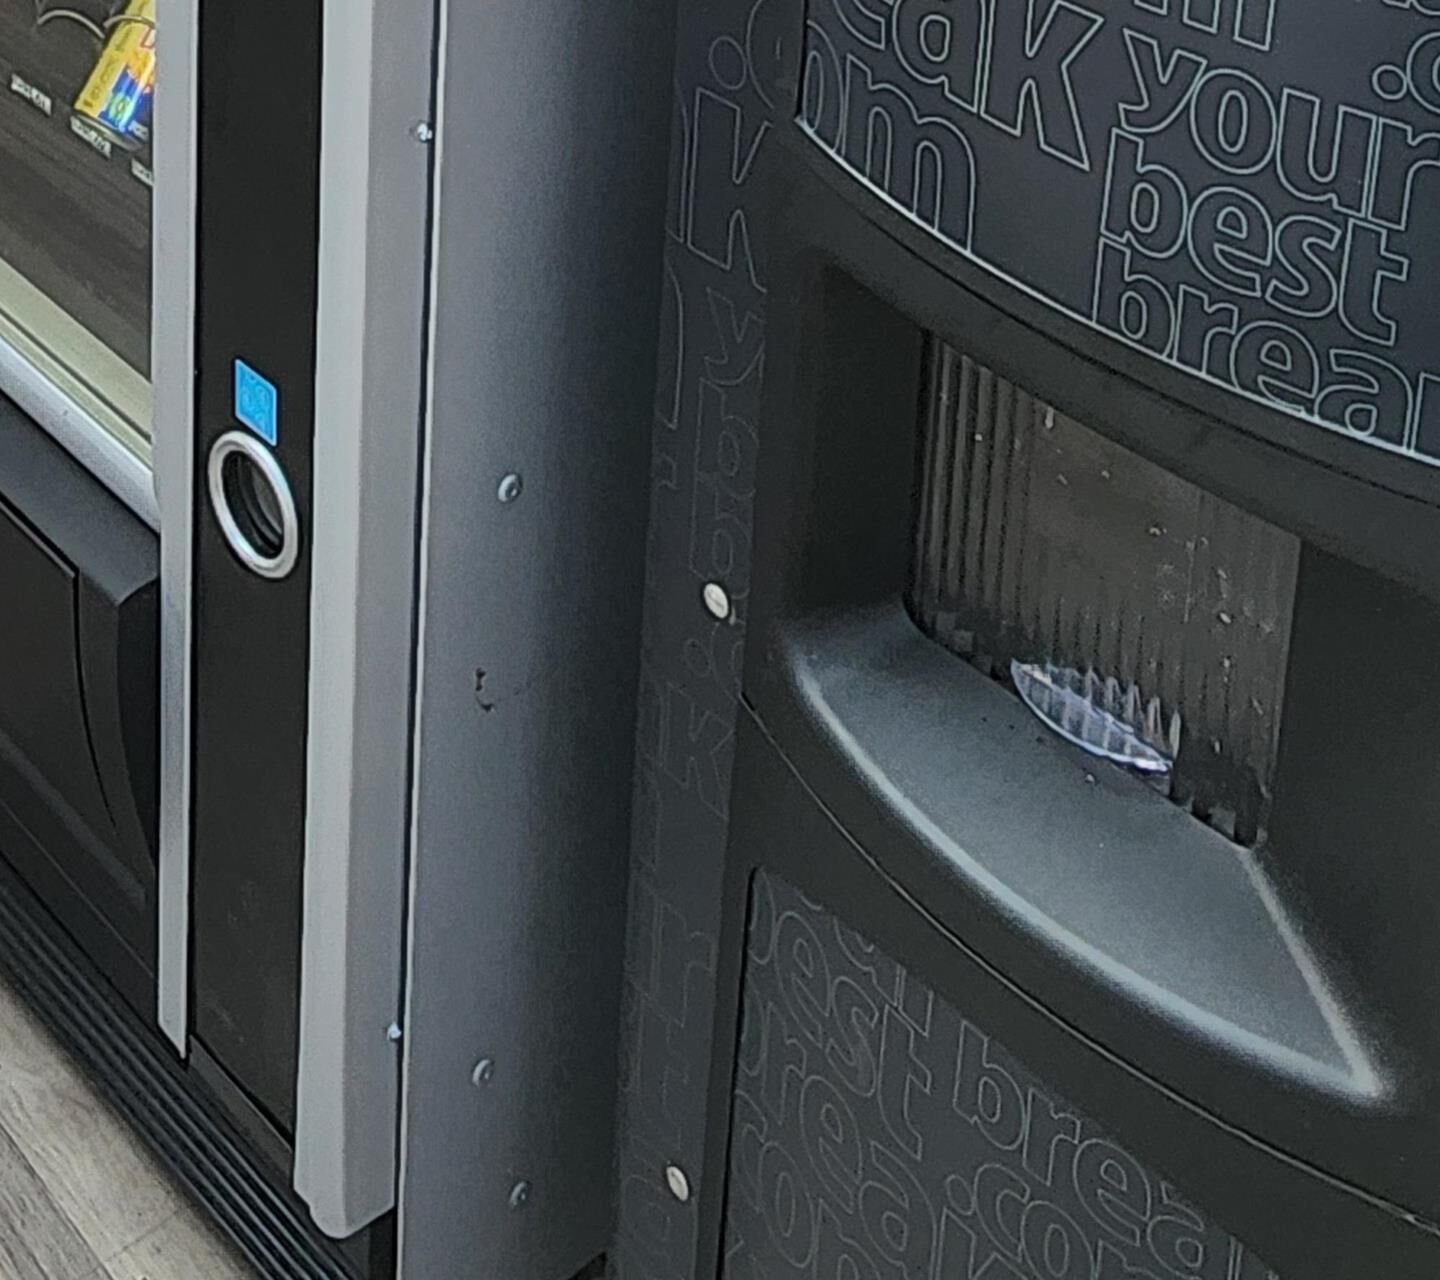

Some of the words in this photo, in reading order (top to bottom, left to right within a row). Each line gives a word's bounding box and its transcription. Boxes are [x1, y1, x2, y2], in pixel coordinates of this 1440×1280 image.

[1100, 126, 1410, 347] best
[1117, 26, 1440, 232] your
[1092, 236, 1440, 462] brea
